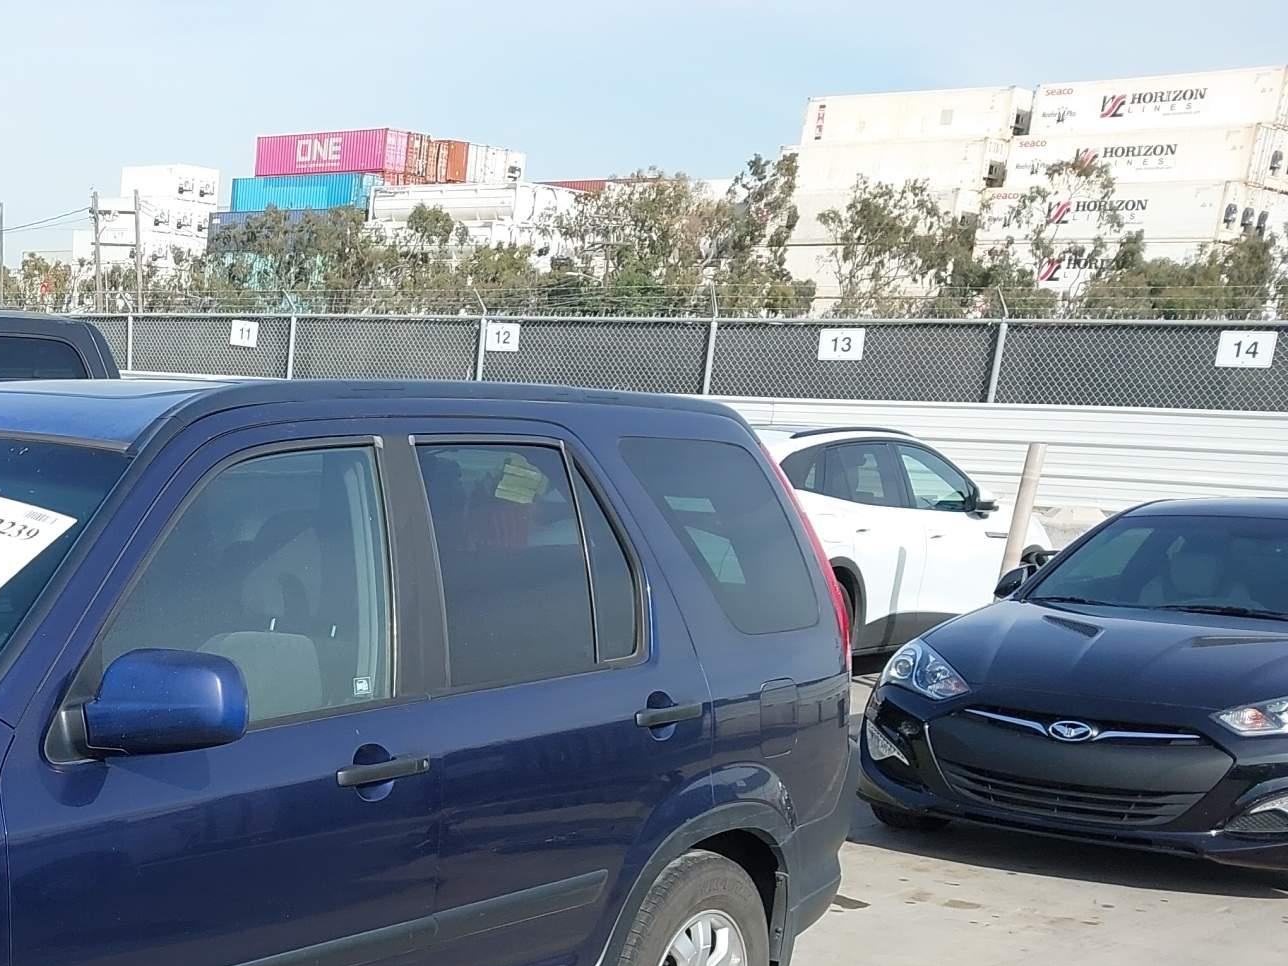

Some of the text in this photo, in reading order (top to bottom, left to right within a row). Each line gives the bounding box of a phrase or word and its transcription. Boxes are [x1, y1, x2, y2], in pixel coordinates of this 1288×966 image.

[1045, 87, 1074, 97] seaco
[1129, 87, 1209, 105] HORIZON
[1127, 102, 1193, 114] LINES
[296, 137, 343, 162] ONE
[1018, 139, 1048, 148] seaco
[1102, 143, 1179, 158] HORIZON
[991, 192, 1020, 200] seaco
[1074, 199, 1149, 212] HORIZON
[1072, 212, 1136, 222] LINS
[238, 327, 252, 341] 11
[495, 330, 511, 345] 12
[831, 336, 852, 353] 13
[1233, 340, 1260, 359] 14
